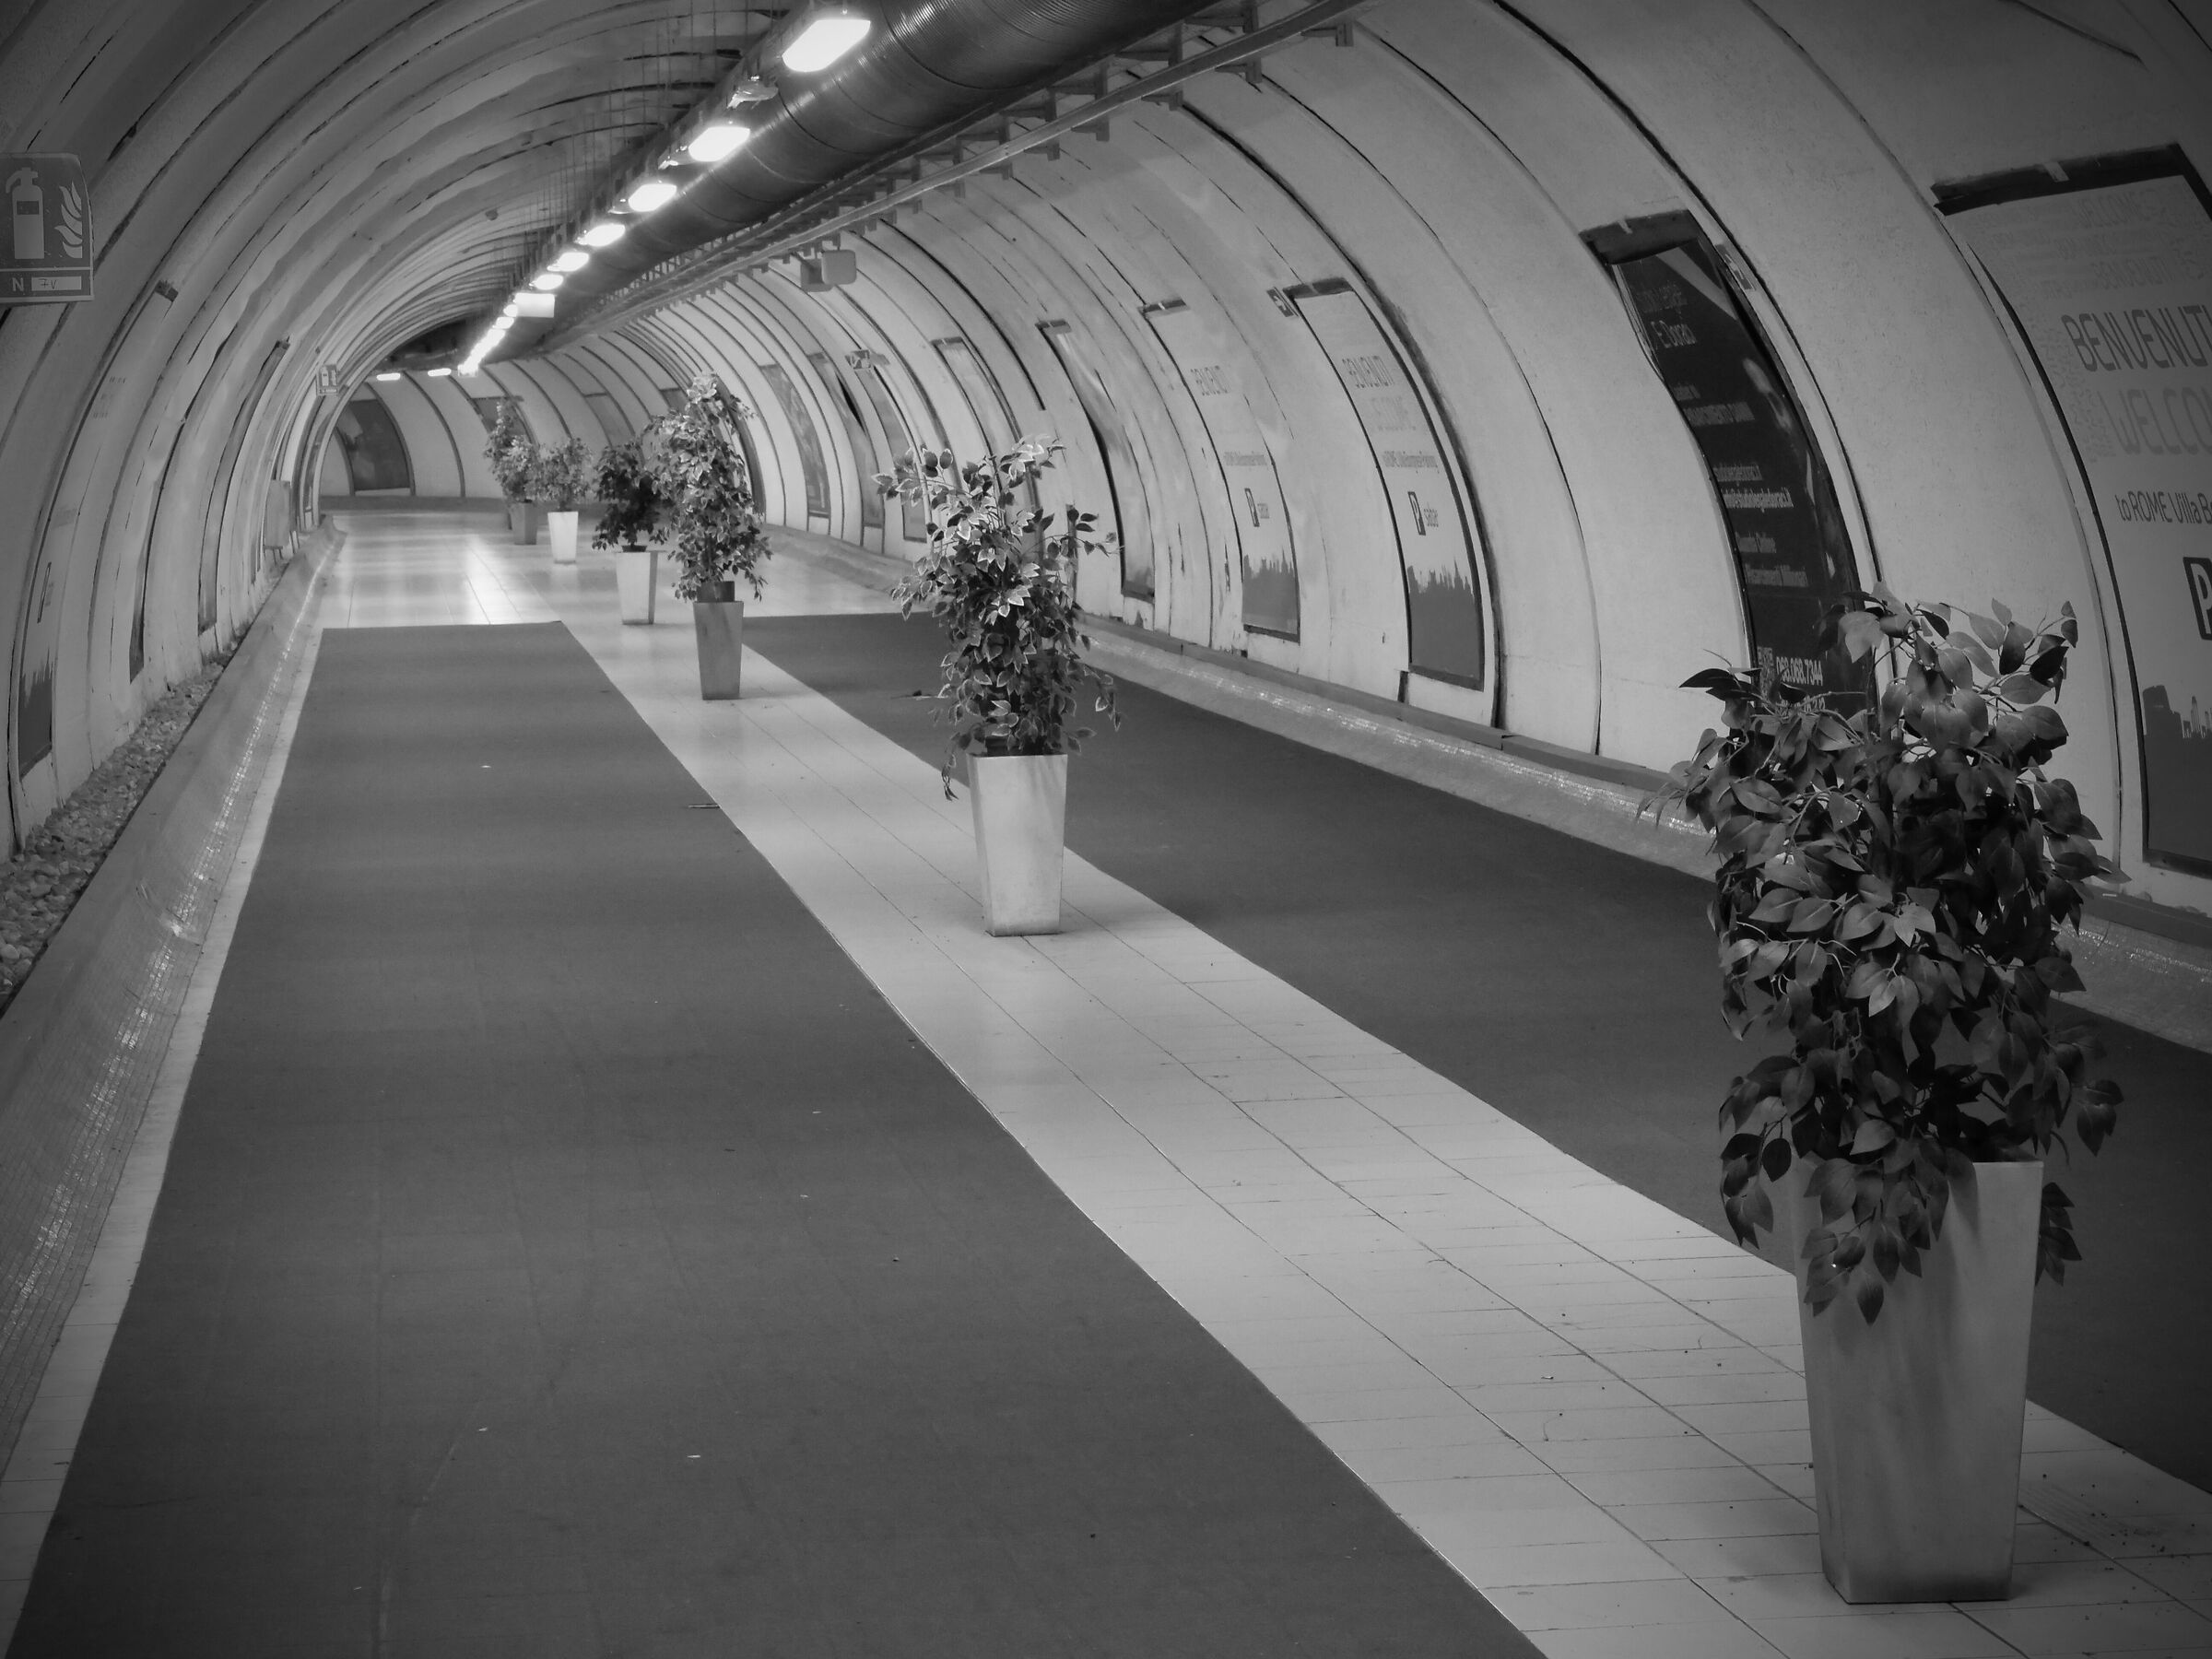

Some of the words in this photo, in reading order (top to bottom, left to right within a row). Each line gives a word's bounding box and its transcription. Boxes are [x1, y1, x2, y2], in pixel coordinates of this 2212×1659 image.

[12, 277, 25, 292] N
[2096, 386, 2212, 455] WELCO
[2127, 490, 2173, 524] ROME
[2167, 491, 2203, 524] Villa
